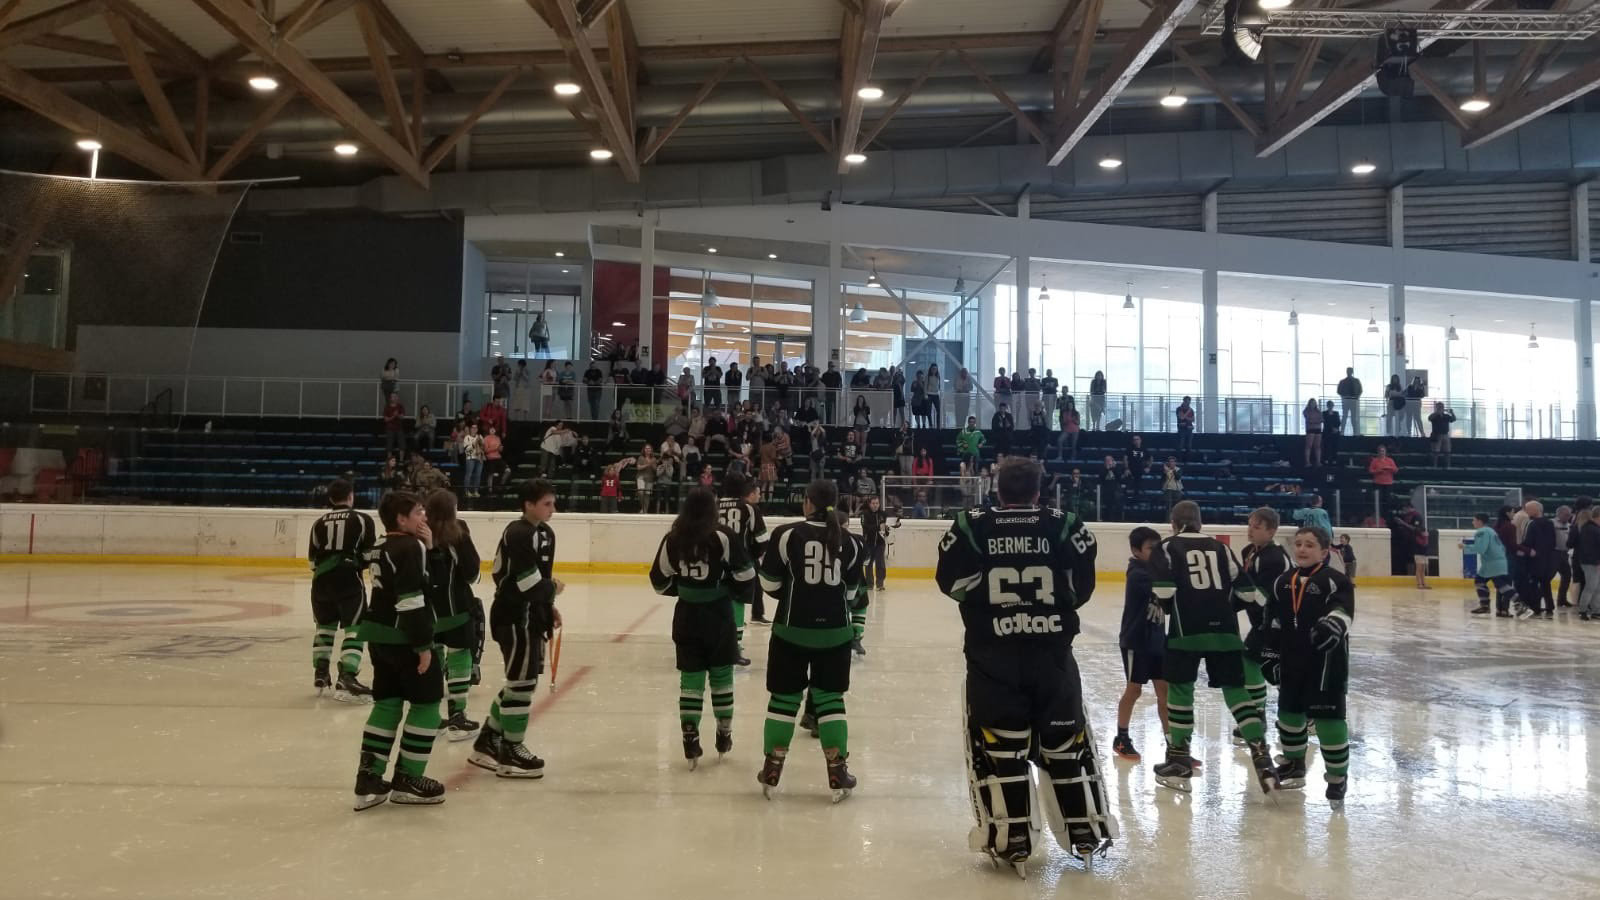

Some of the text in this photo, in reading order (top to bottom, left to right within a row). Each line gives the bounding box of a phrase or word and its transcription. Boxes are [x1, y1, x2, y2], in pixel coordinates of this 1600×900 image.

[324, 519, 346, 551] 11
[988, 536, 1050, 555] BERMEJO
[1070, 524, 1096, 554] 63
[804, 540, 842, 586] 35
[1186, 549, 1224, 590] 31
[988, 565, 1055, 606] 63
